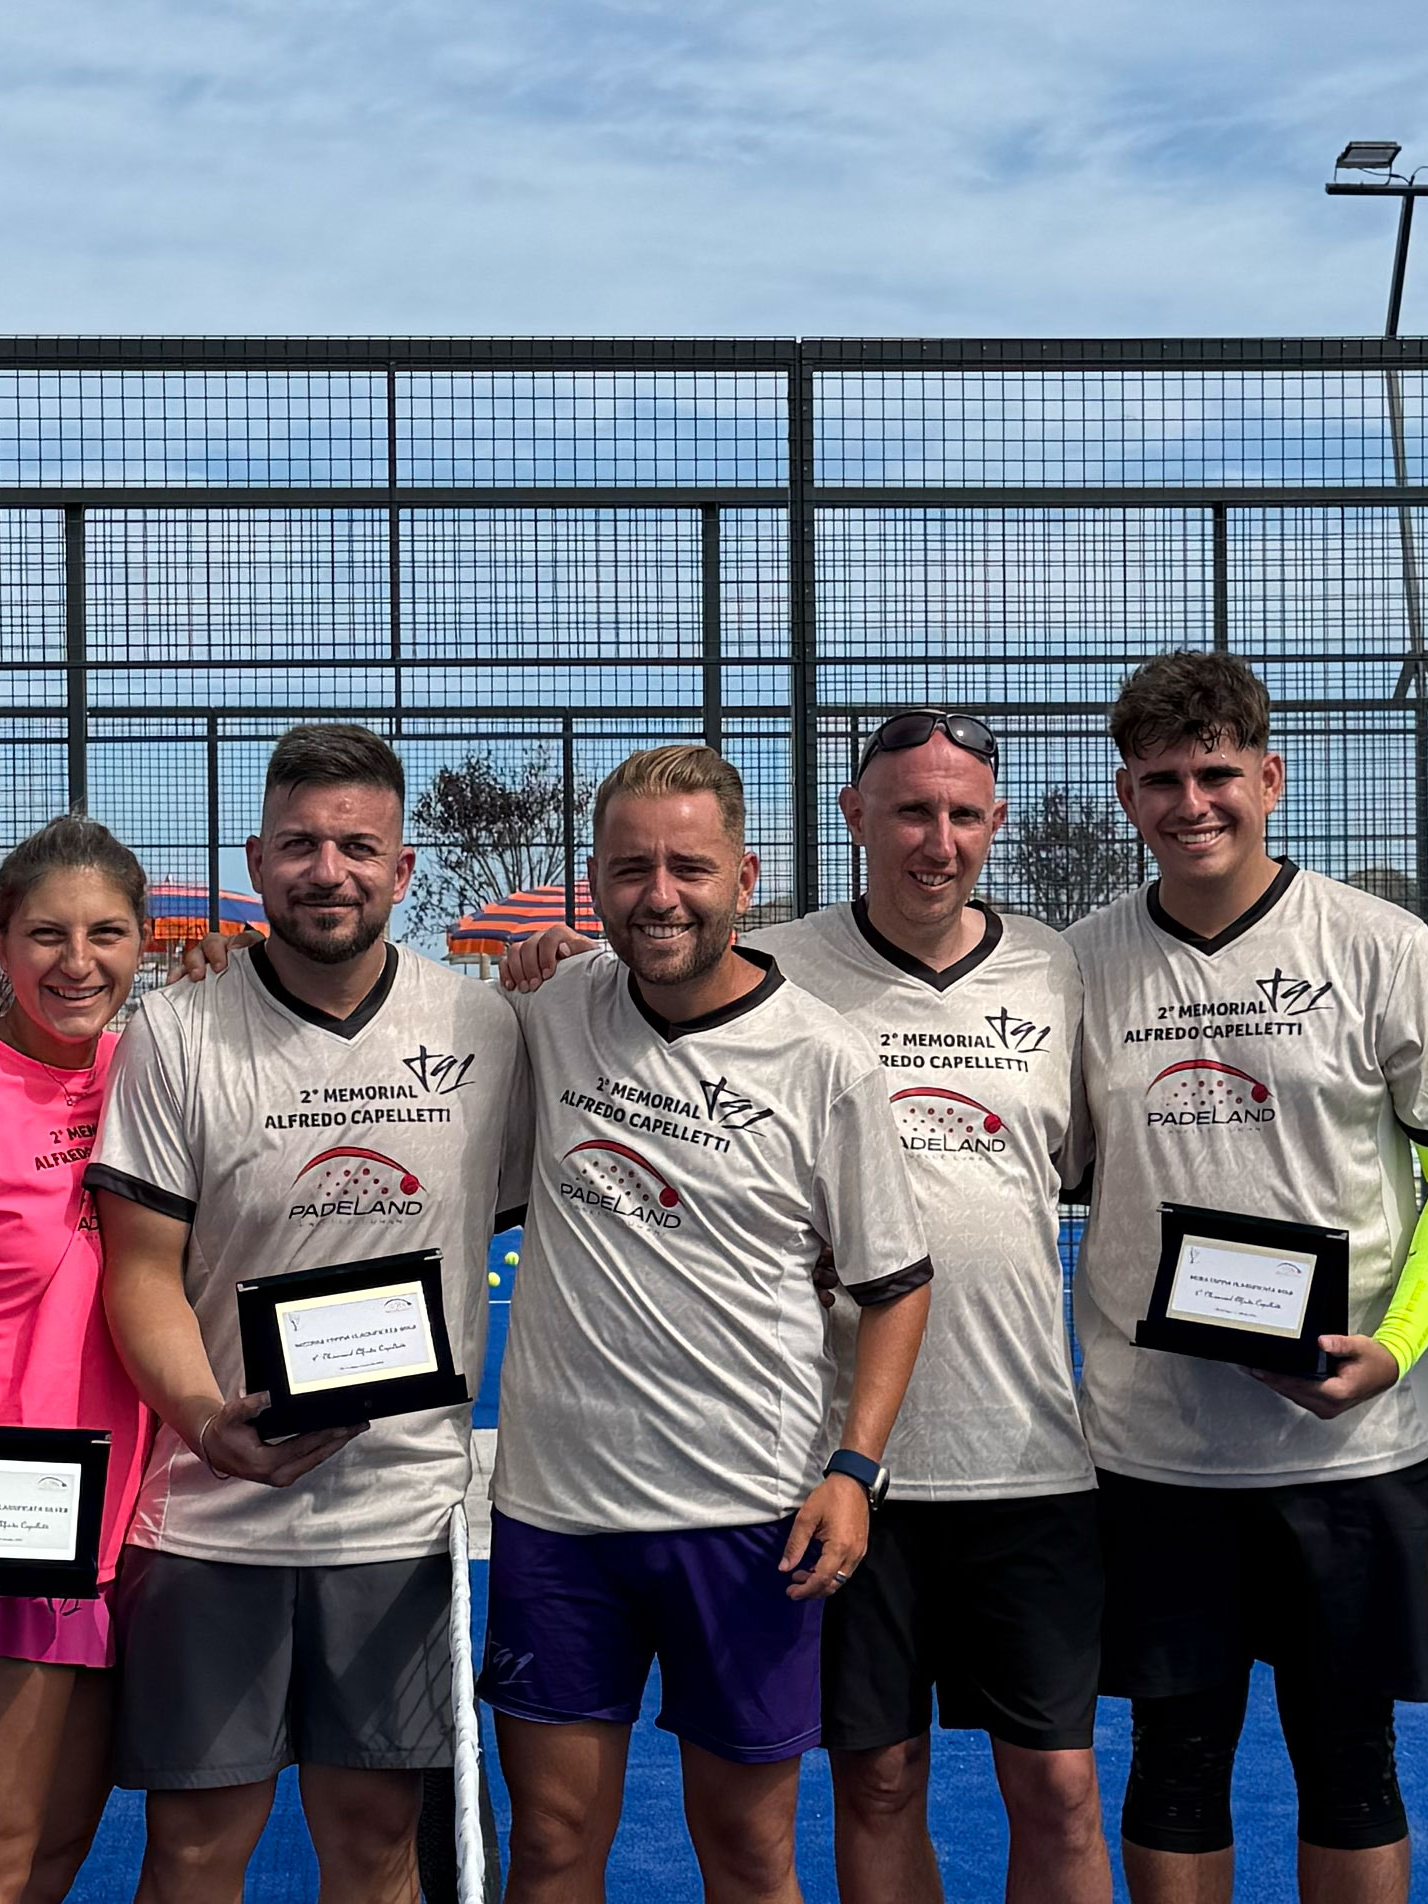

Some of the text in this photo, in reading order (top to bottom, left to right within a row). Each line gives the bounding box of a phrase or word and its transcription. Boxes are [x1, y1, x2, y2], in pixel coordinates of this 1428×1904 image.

[1178, 1000, 1267, 1018] MEMORIAL
[902, 1033, 995, 1049] MEMORIAL
[1123, 1022, 1303, 1043] ALFREDO CAPELLETTI
[879, 1055, 1029, 1072] REDO CAPELLETTI
[324, 1085, 418, 1103] MEMORIAL
[610, 1082, 701, 1120] MEMORIAL
[264, 1108, 450, 1129] ALFREDO CAPELLETTI
[560, 1089, 731, 1153] ALFREDO CAPELLETTI
